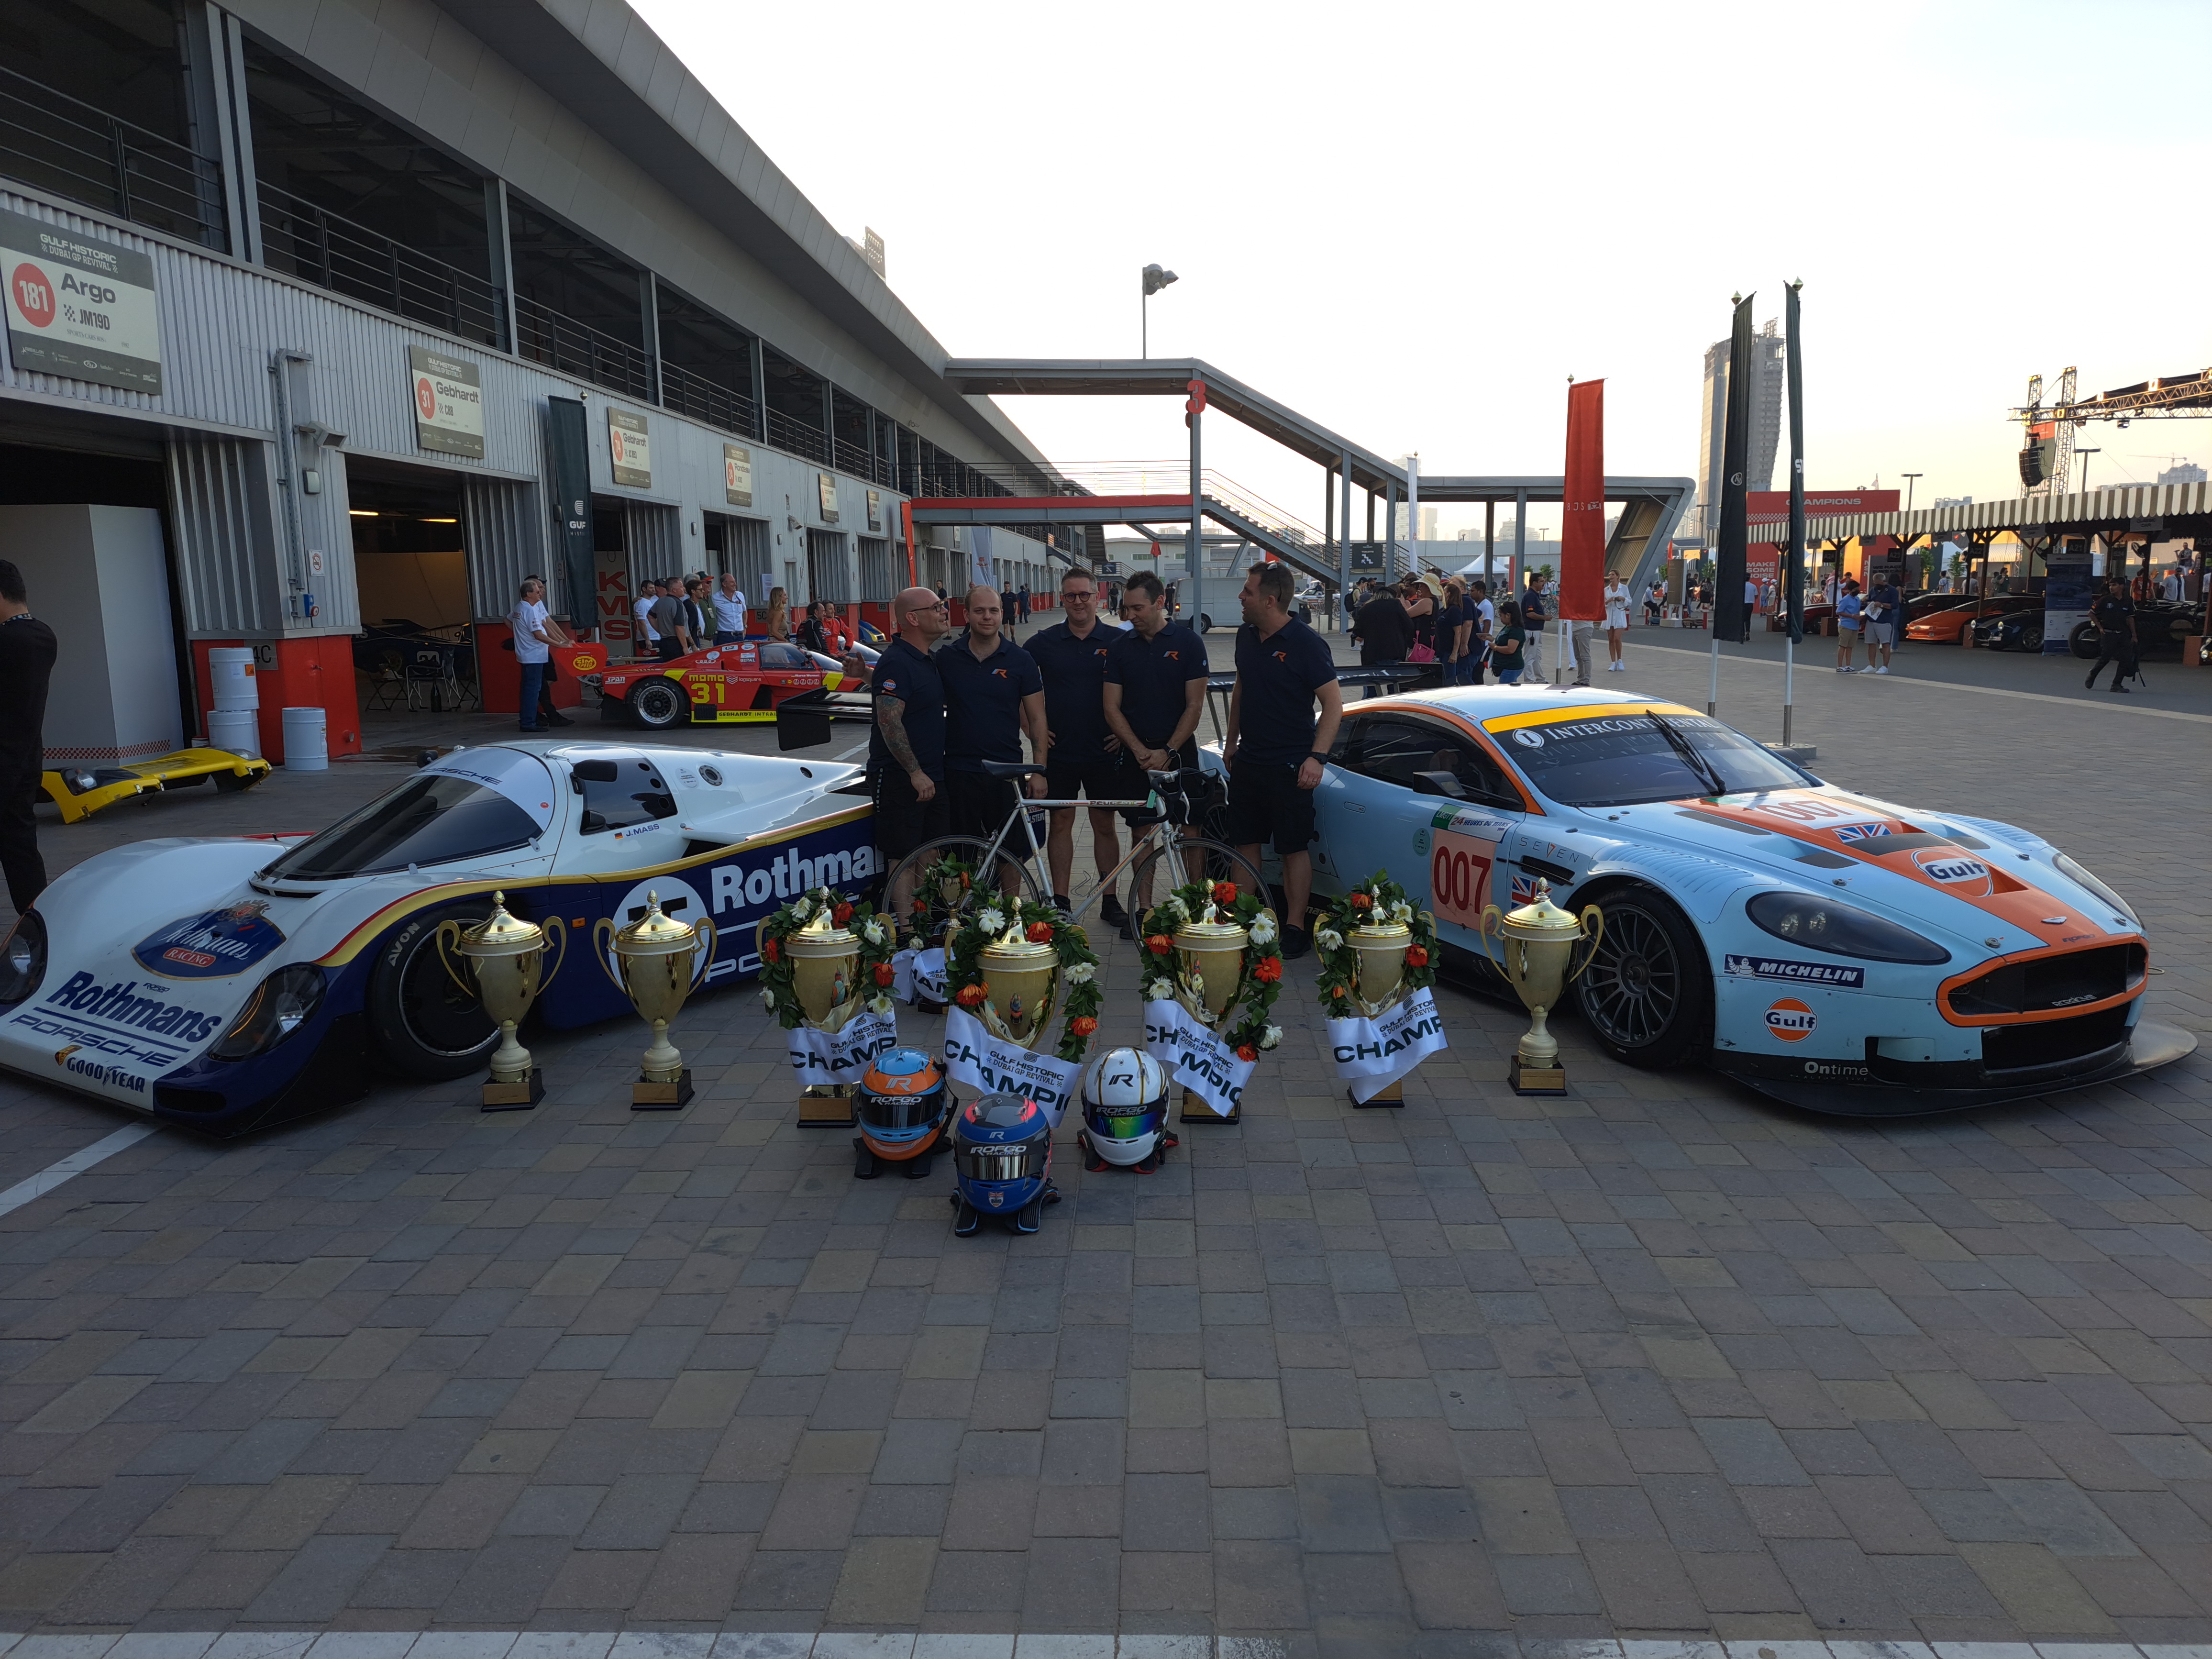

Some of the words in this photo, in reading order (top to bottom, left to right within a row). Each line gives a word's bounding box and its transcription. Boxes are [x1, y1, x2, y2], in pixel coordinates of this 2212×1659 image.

[40, 233, 68, 247] GULF
[70, 243, 117, 264] HISTORIC
[49, 244, 71, 259] DUBAI
[72, 252, 81, 263] GP
[83, 255, 111, 271] REVIVAL
[19, 280, 49, 312] 181
[61, 272, 116, 304] Argo
[80, 309, 111, 331] JM19D
[428, 357, 441, 365] GULF
[440, 361, 462, 372] HISTORIC
[421, 390, 431, 409] 31
[436, 381, 479, 404] Gebhardt
[615, 440, 621, 453] 74
[623, 432, 647, 447] Gebhardt
[734, 462, 751, 474] Rondeau
[691, 683, 725, 704] 31
[1543, 718, 1721, 740] INTERCONTIENTAL
[1756, 800, 1854, 821] 007
[626, 823, 660, 837] J.MASS
[1451, 817, 1464, 826] 24
[1434, 846, 1492, 915] 007
[1925, 861, 1988, 881] Gulf
[157, 919, 259, 960] Rothmans
[387, 922, 421, 967] AVON
[167, 948, 210, 965] RACING
[1758, 962, 1858, 982] MICHELIN
[45, 970, 222, 1043] Rothmans
[2051, 994, 2097, 1007] prodrive
[1379, 1018, 1404, 1032] GULF
[1386, 1020, 1405, 1035] DUBAI
[1405, 1014, 1414, 1023] GP
[1765, 1012, 1816, 1029] Gulf
[9, 1014, 177, 1067] PORSCHE
[856, 1033, 866, 1042] GP
[866, 1027, 893, 1039] REVIVAL
[1179, 1026, 1201, 1043] GULF
[1180, 1035, 1197, 1051] DUBAI
[989, 1050, 1017, 1064] GULF
[1016, 1062, 1065, 1081] HISTORIC
[993, 1058, 1015, 1073] DUBAI
[1014, 1068, 1026, 1076] GP
[1026, 1071, 1055, 1086] REVIVAL
[1804, 1061, 1869, 1075] Ontime
